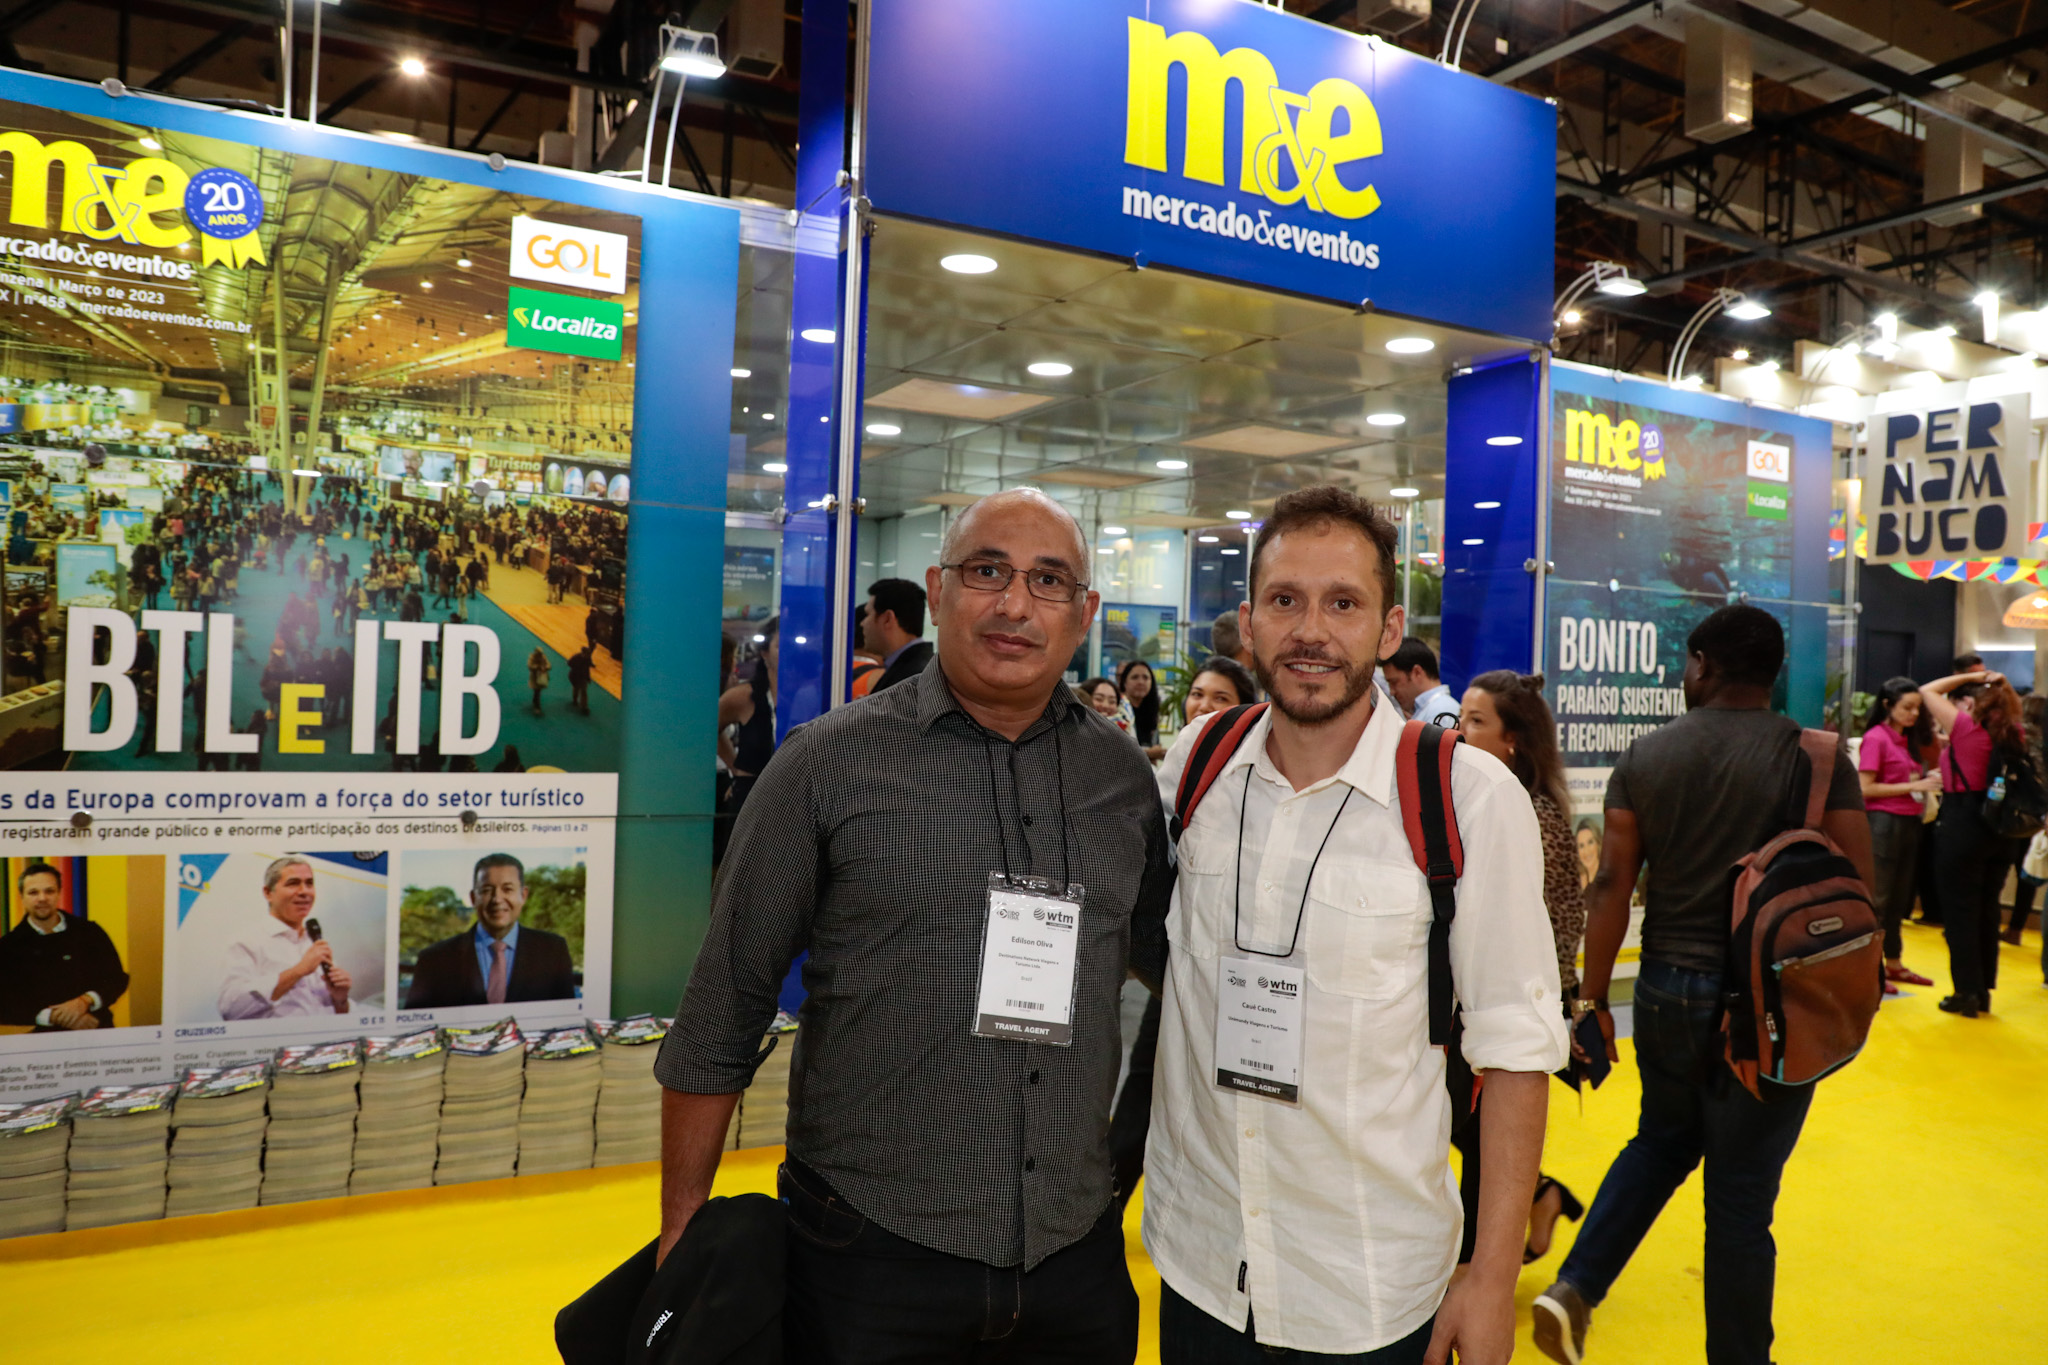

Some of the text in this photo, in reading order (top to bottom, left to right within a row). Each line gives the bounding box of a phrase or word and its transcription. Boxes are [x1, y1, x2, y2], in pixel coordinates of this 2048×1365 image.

[1124, 16, 1383, 219] m&e
[200, 182, 246, 212] 20
[208, 213, 248, 226] ANOS
[1122, 186, 1380, 270] mercado&eventos
[527, 234, 611, 279] GOL
[58, 279, 102, 297] Março
[106, 286, 125, 299] de
[129, 288, 165, 305] 2023
[79, 301, 252, 333] mercadoeeventos.com.br
[531, 309, 618, 340] Localiza
[1643, 431, 1659, 450] 20
[1886, 402, 2003, 458] PER
[487, 455, 542, 473] Turismo
[1753, 450, 1783, 474] GOL
[1755, 493, 1786, 510] Localiza
[1876, 504, 2008, 556] BUCO
[1560, 616, 1666, 684] BONITO,
[63, 607, 501, 755] BTL E ITB
[1557, 678, 1619, 715] PARAÍSO
[1556, 723, 1565, 752] E
[24, 789, 55, 809] da
[67, 789, 154, 813] Europa
[166, 792, 306, 812] comprovam
[316, 793, 328, 807] a
[337, 789, 393, 812] força
[402, 789, 429, 807] do
[438, 790, 492, 807] setor
[501, 788, 585, 806] turístico
[2, 825, 92, 841] registraram
[97, 826, 150, 841] grande
[156, 824, 208, 840] público
[215, 828, 222, 836] e
[229, 826, 282, 837] enorme
[288, 821, 371, 839] participação
[378, 823, 399, 834] dos
[404, 822, 457, 834] destinos
[1047, 911, 1073, 924] wtm
[1011, 936, 1053, 948] Edilson Oliva
[1270, 980, 1297, 992] wtm
[396, 1013, 433, 1023] POLÍTICA
[1257, 1005, 1277, 1014] Castro
[175, 1026, 226, 1038] CRUZEIROS
[995, 1022, 1050, 1036] TRAVEL AGENT
[1232, 1077, 1281, 1094] TRAVEL AGENT
